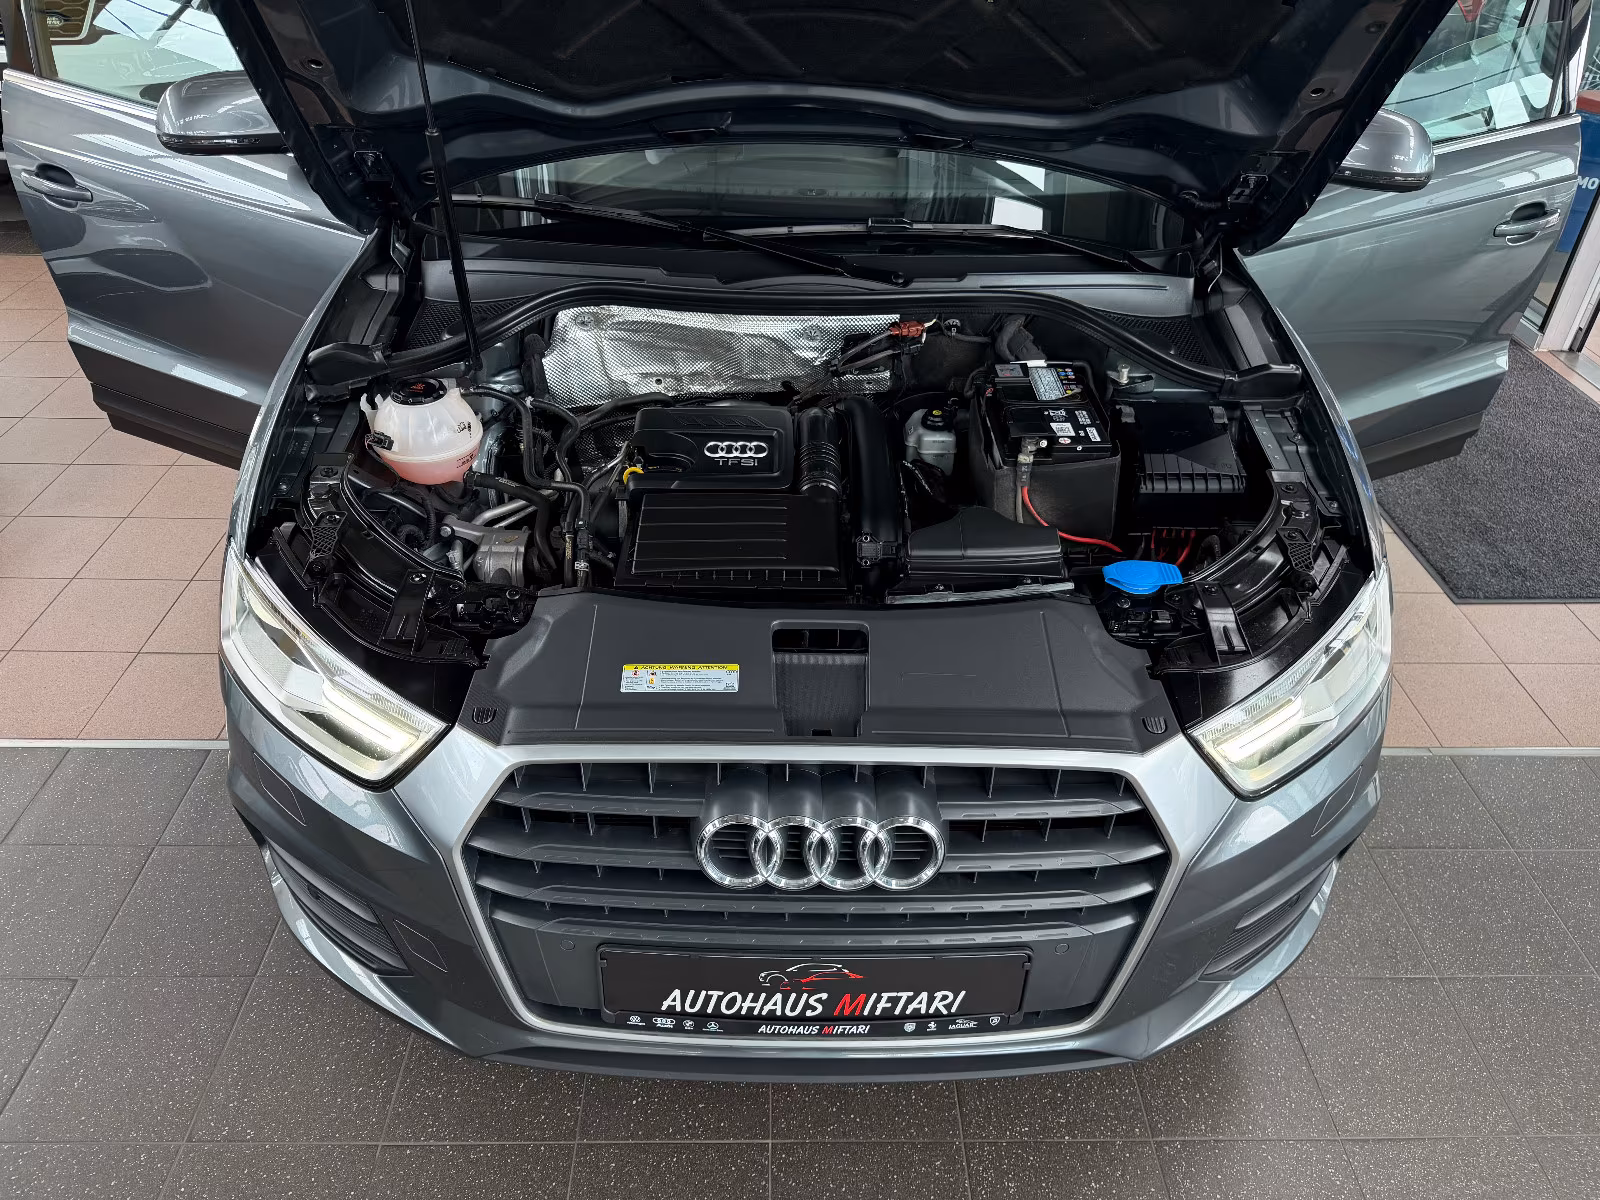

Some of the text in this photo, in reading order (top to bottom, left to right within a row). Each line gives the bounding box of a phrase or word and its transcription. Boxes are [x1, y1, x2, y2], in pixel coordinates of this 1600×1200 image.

[714, 458, 758, 466] TFSI
[661, 989, 966, 1017] AUTOHAUS MIFTARI
[758, 1024, 870, 1035] AUTOHAUS MIFTARI
